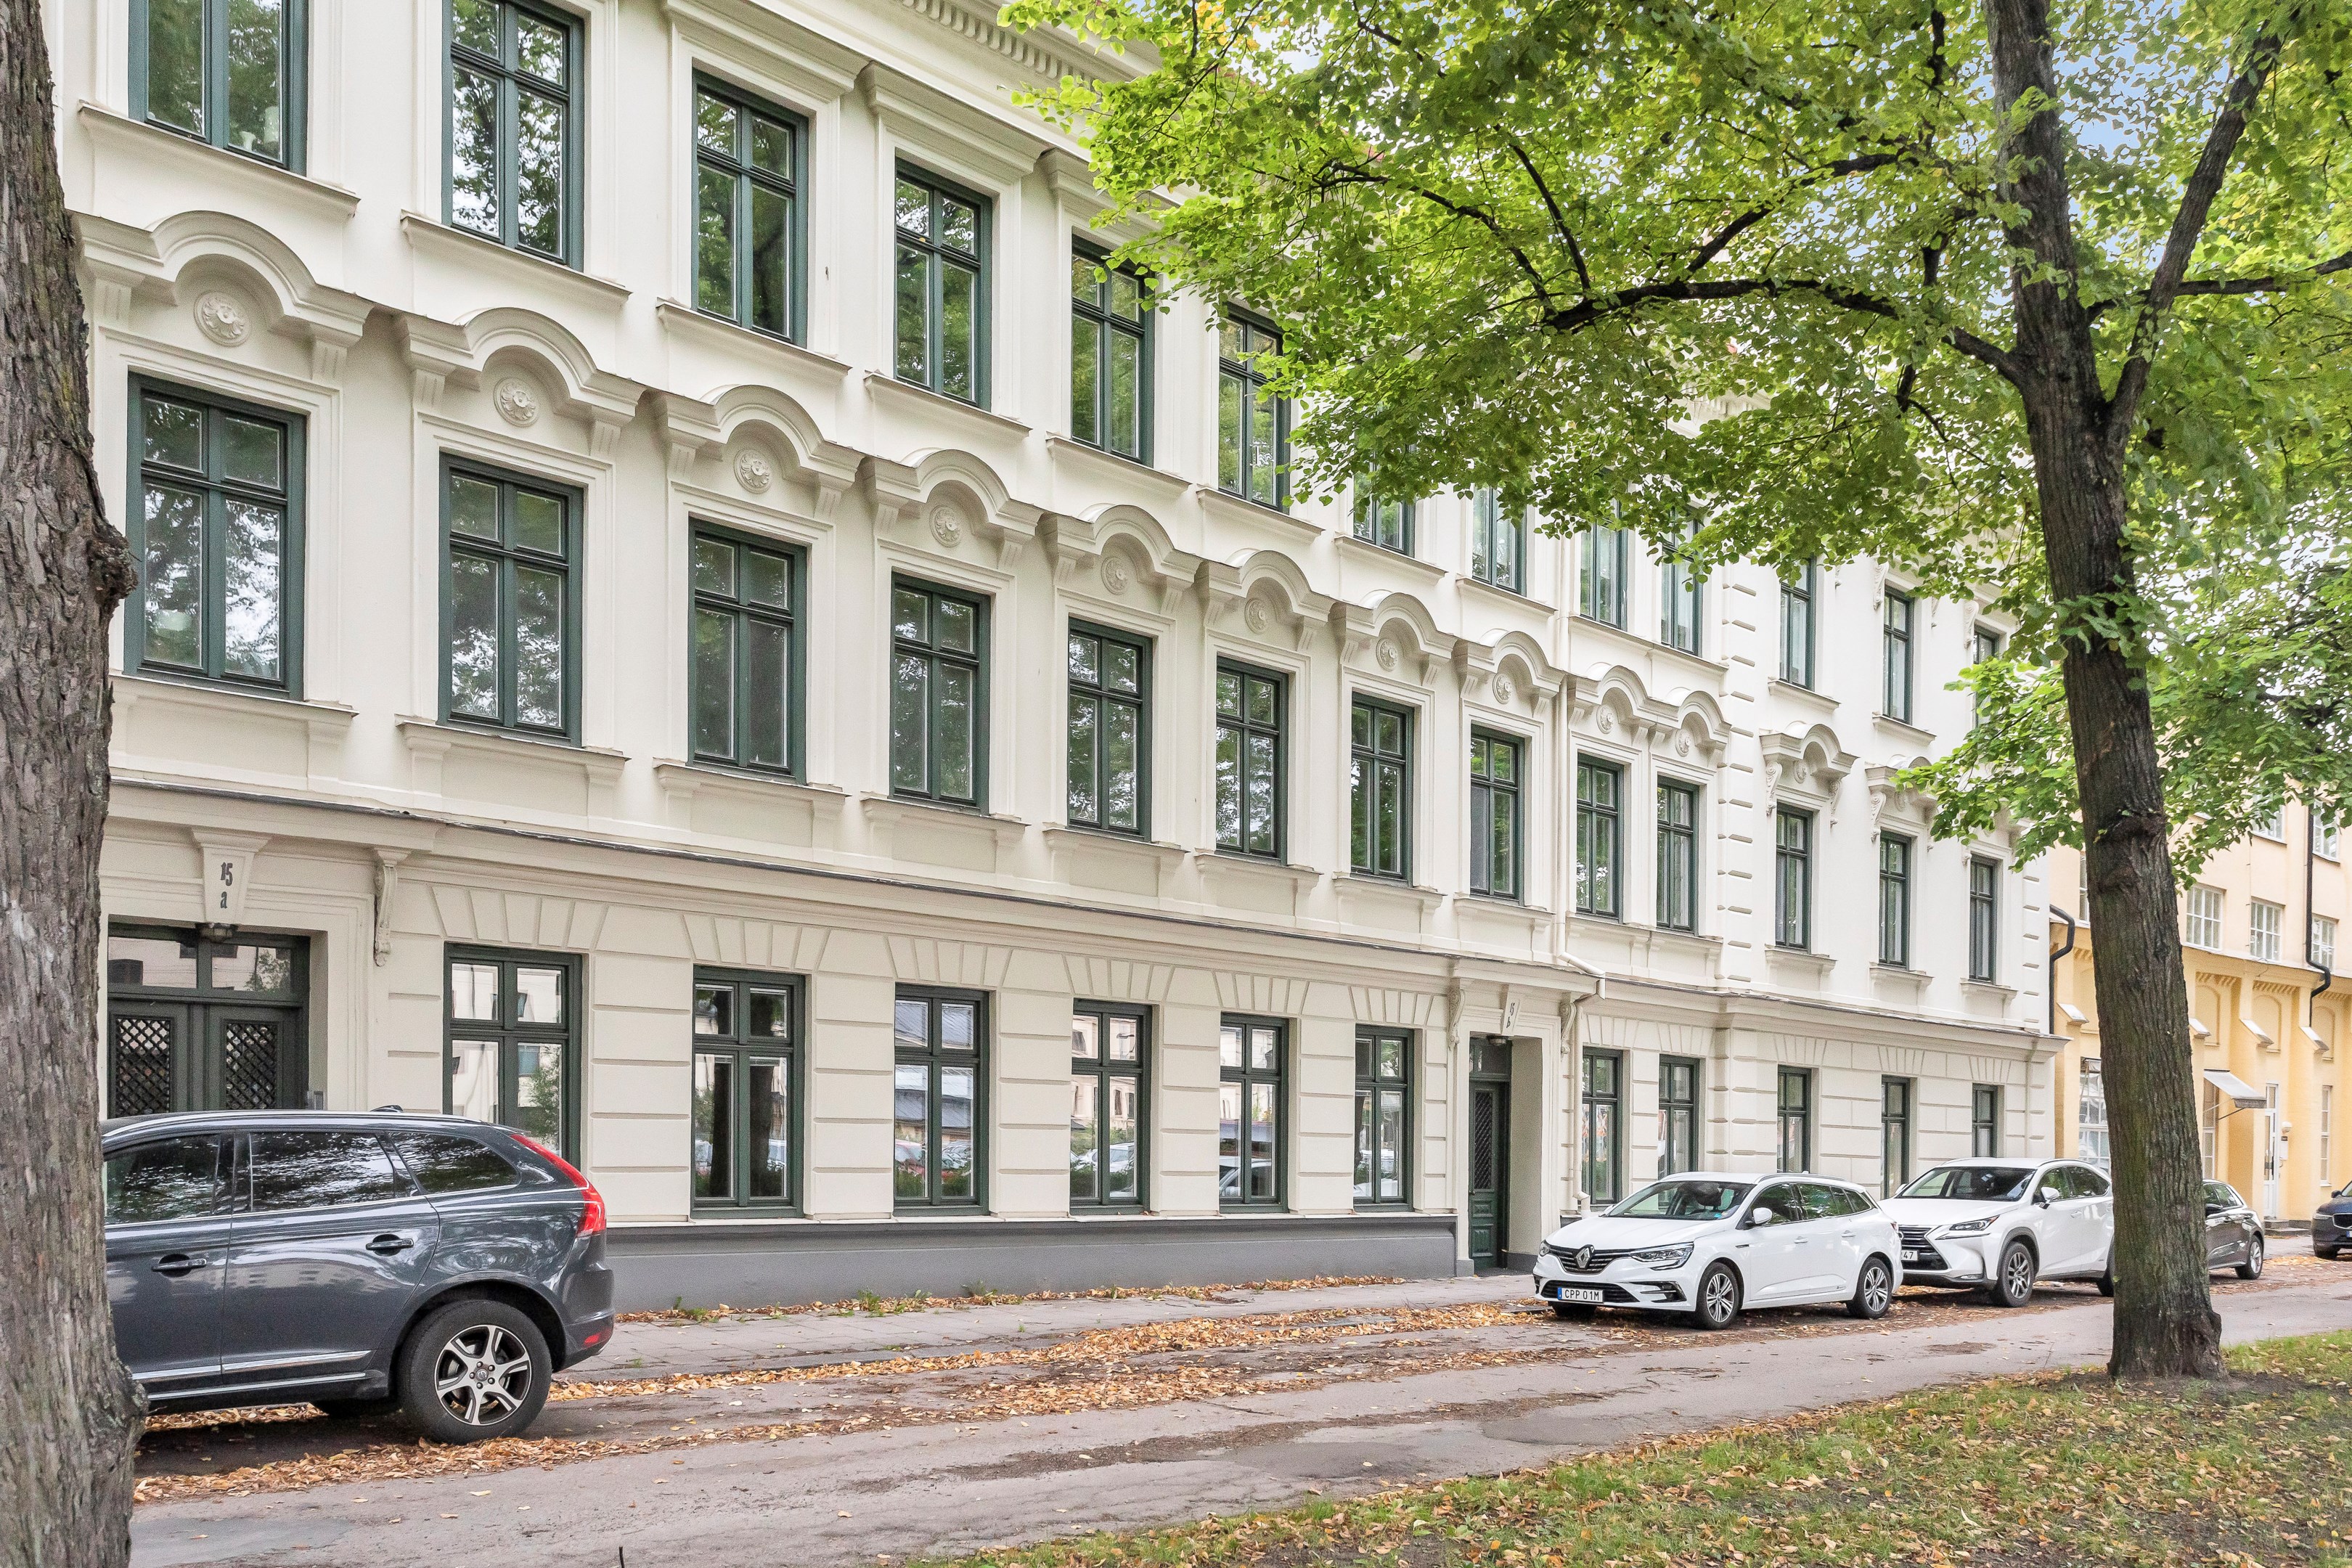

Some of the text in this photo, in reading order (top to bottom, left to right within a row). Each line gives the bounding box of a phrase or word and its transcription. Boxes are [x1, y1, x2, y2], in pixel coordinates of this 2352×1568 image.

[221, 862, 233, 886] 15
[221, 891, 227, 909] a
[1506, 1016, 1511, 1028] b
[1565, 1289, 1580, 1299] CPP
